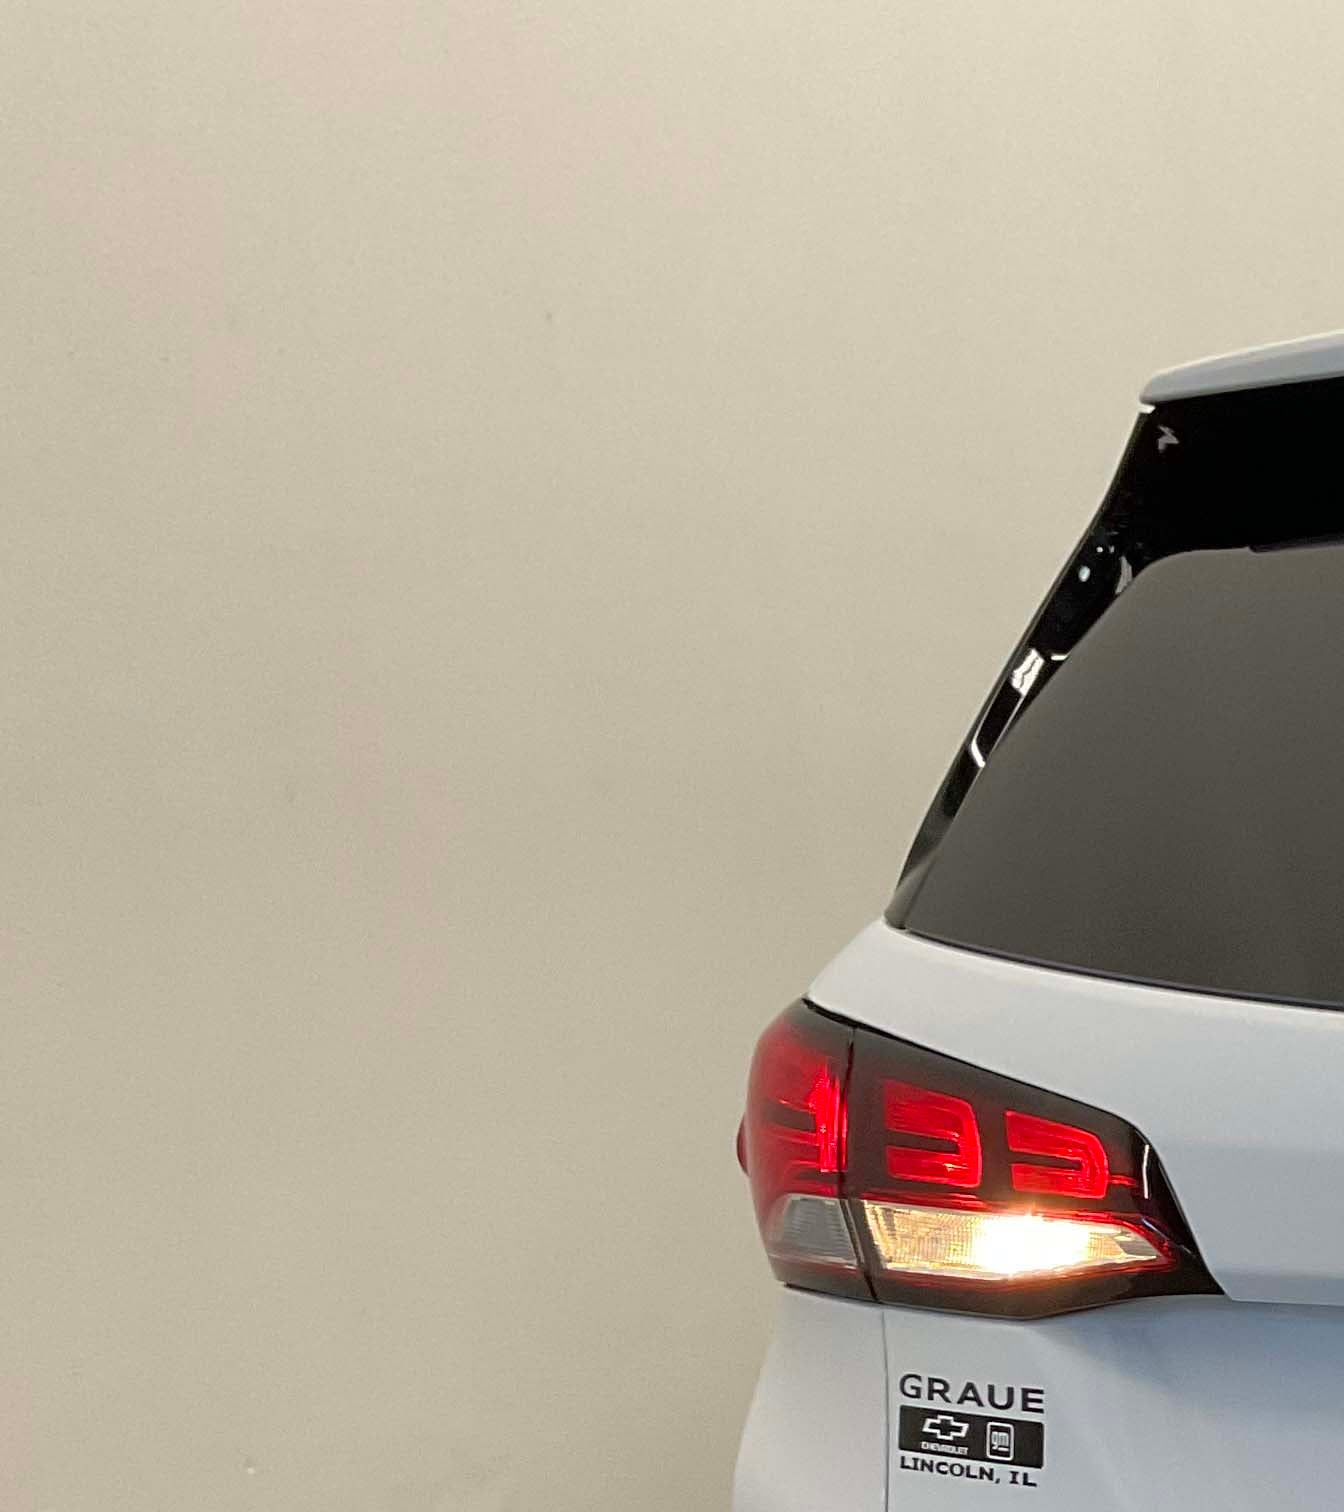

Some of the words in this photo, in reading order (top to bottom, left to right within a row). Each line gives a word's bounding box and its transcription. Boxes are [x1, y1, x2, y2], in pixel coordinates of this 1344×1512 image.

[899, 1373, 1045, 1414] GRAUE
[900, 1455, 1001, 1484] LINCOLN,
[1009, 1470, 1038, 1487] IL
